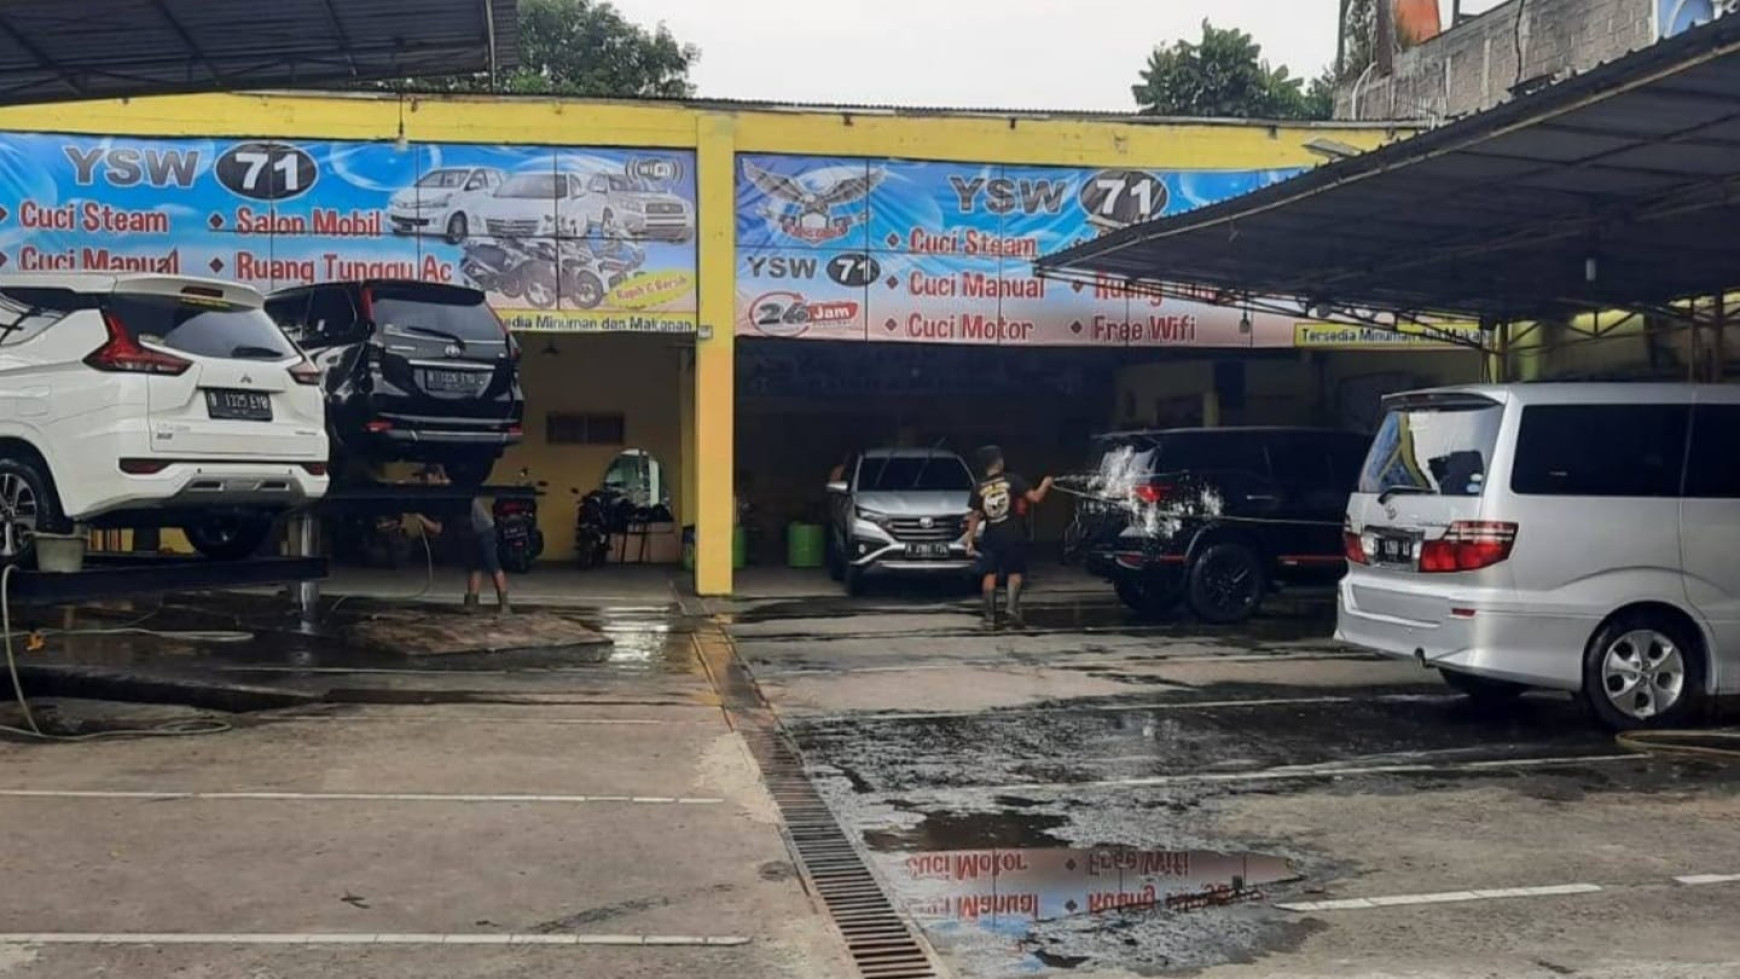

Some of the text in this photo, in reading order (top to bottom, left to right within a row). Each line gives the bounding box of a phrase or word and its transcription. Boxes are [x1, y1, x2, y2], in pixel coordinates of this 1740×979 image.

[65, 147, 299, 191] YSW 71
[950, 176, 1152, 215] YSW 71
[20, 201, 168, 232] Cuci Steam
[237, 207, 382, 237] Salon Mobil
[910, 228, 1036, 257] Cuci Steam
[20, 247, 180, 274] Cuci Manual
[237, 252, 314, 281] Ruang
[422, 255, 452, 281] Ac
[747, 256, 872, 282] YSW 71
[909, 273, 1044, 299] Cuci Manual
[536, 314, 598, 330] Minuman
[602, 316, 627, 330] dan
[630, 316, 692, 331] Makanan
[814, 306, 850, 320] Jam
[908, 314, 1034, 340] Cuci Motor
[1094, 315, 1196, 341] Free Wifi
